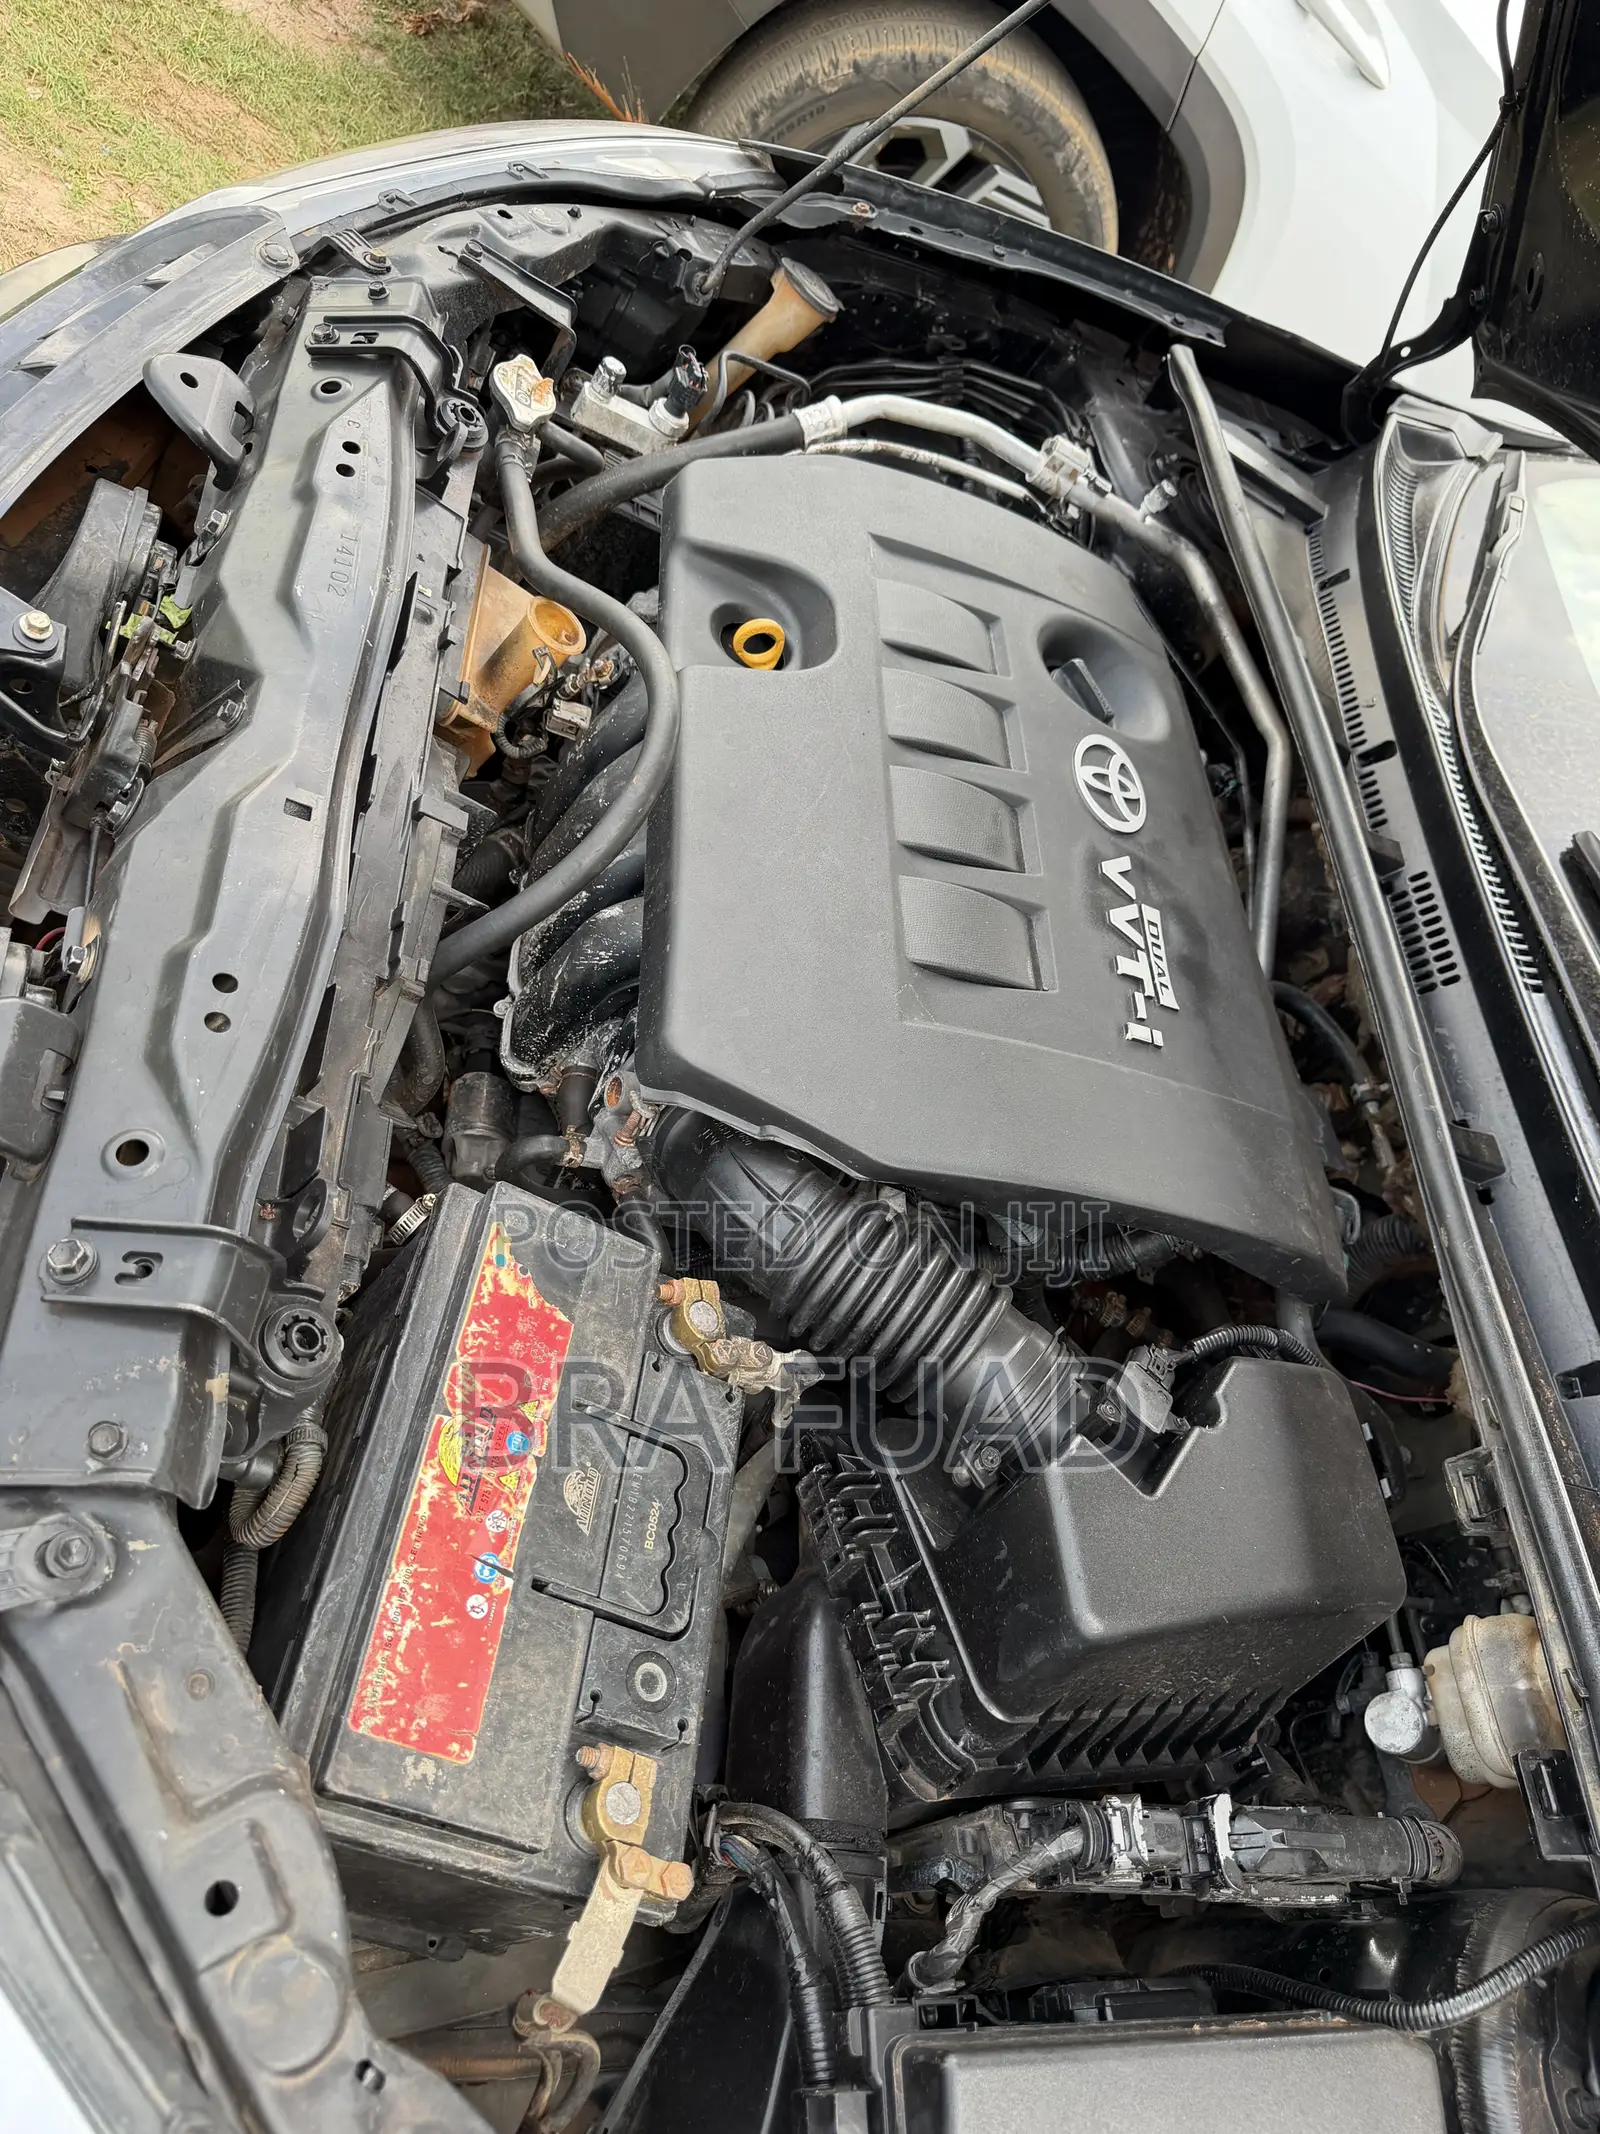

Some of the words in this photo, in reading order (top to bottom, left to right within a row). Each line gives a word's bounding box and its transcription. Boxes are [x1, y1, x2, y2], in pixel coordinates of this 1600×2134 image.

[327, 533, 359, 598] 14102
[1100, 856, 1164, 1049] VVT-i
[1146, 919, 1171, 997] DUAL
[644, 1499, 661, 1550] BC0524
